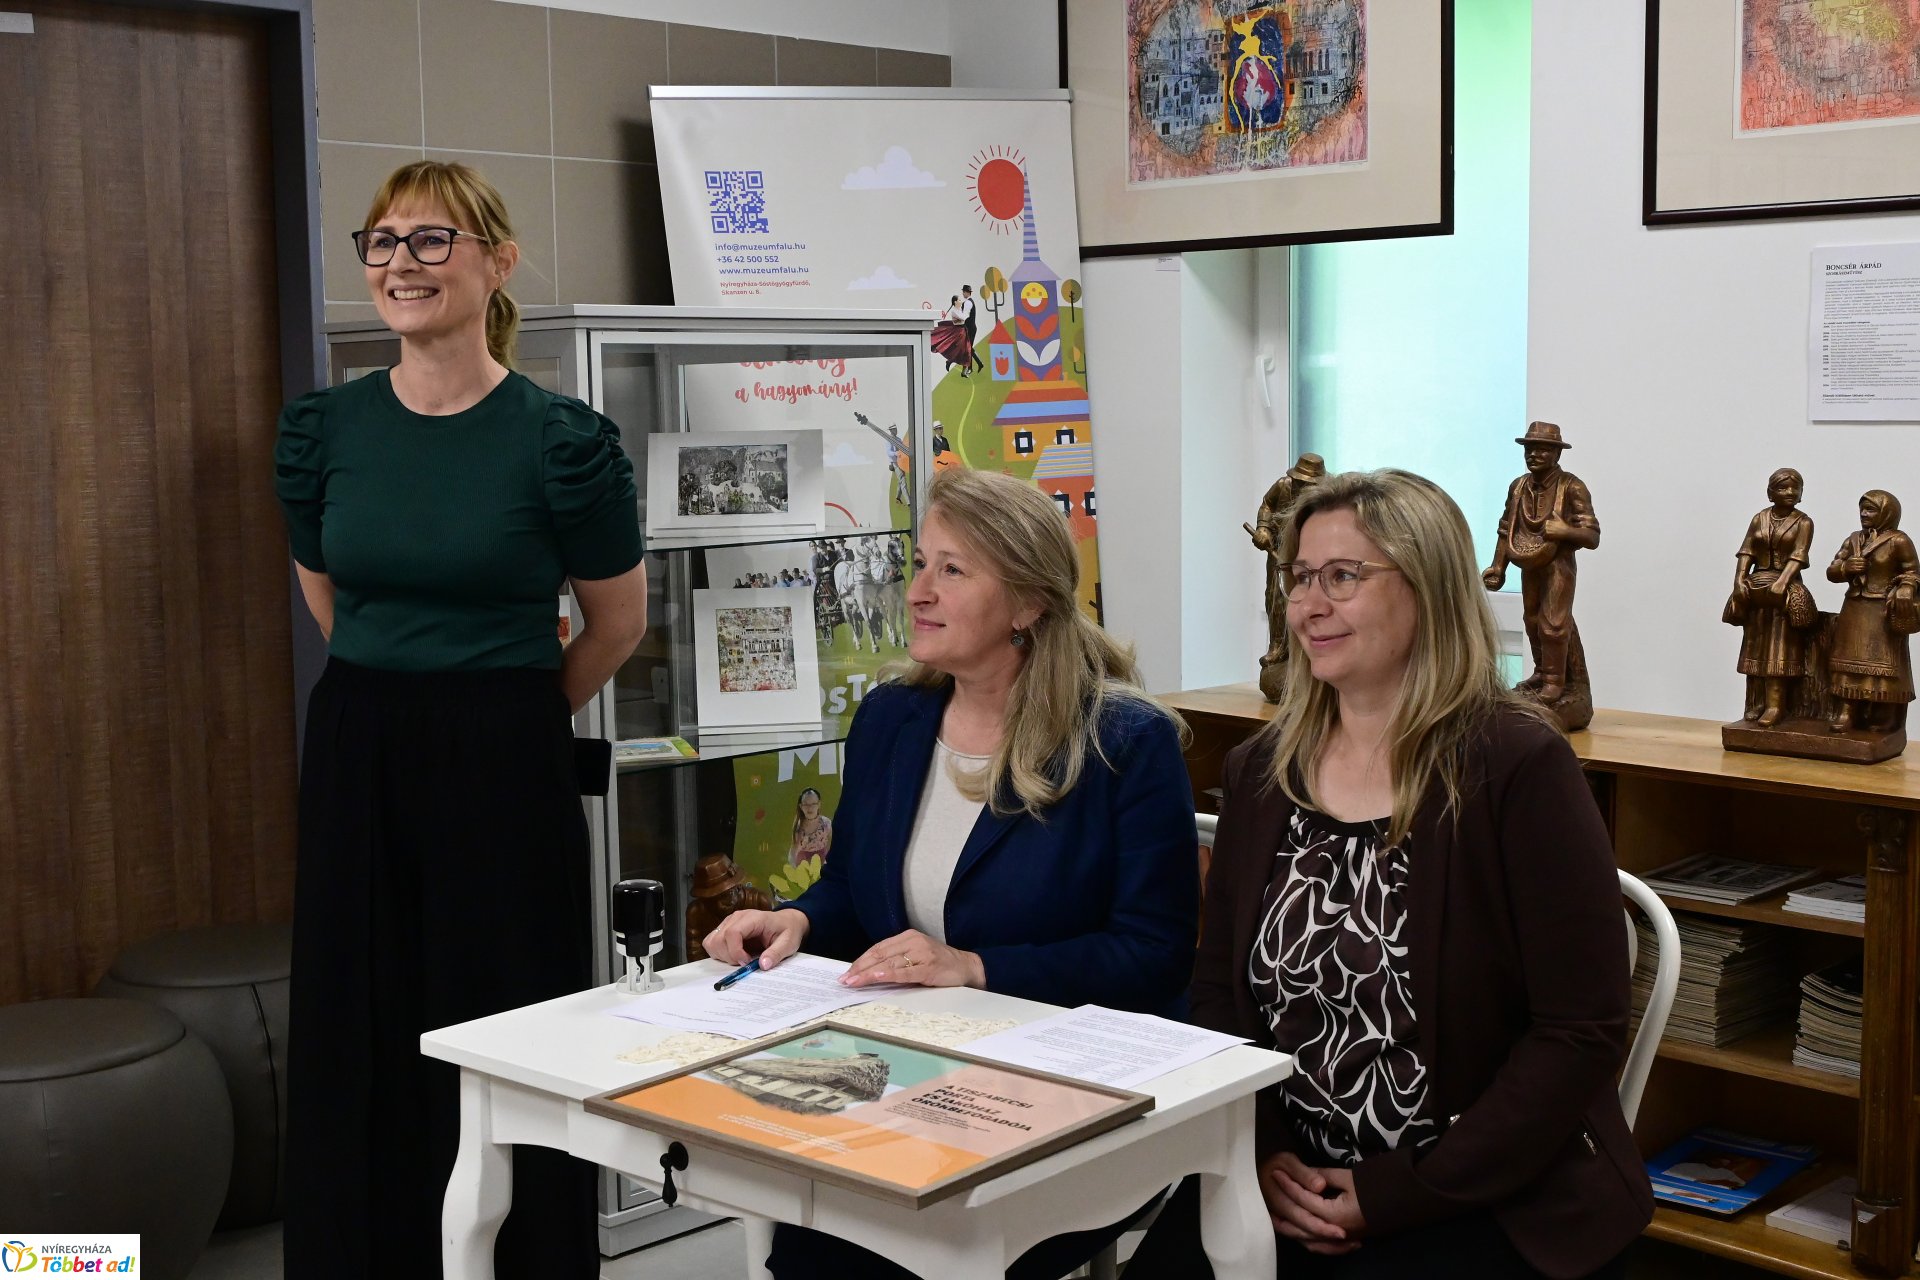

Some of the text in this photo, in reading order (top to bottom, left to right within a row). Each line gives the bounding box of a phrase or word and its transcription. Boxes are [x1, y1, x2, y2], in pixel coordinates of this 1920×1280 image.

[715, 243, 806, 252] info@muzeumfalu.hu
[719, 267, 809, 275] www.muzeumfalu.hu
[735, 377, 858, 404] a hagyomány!
